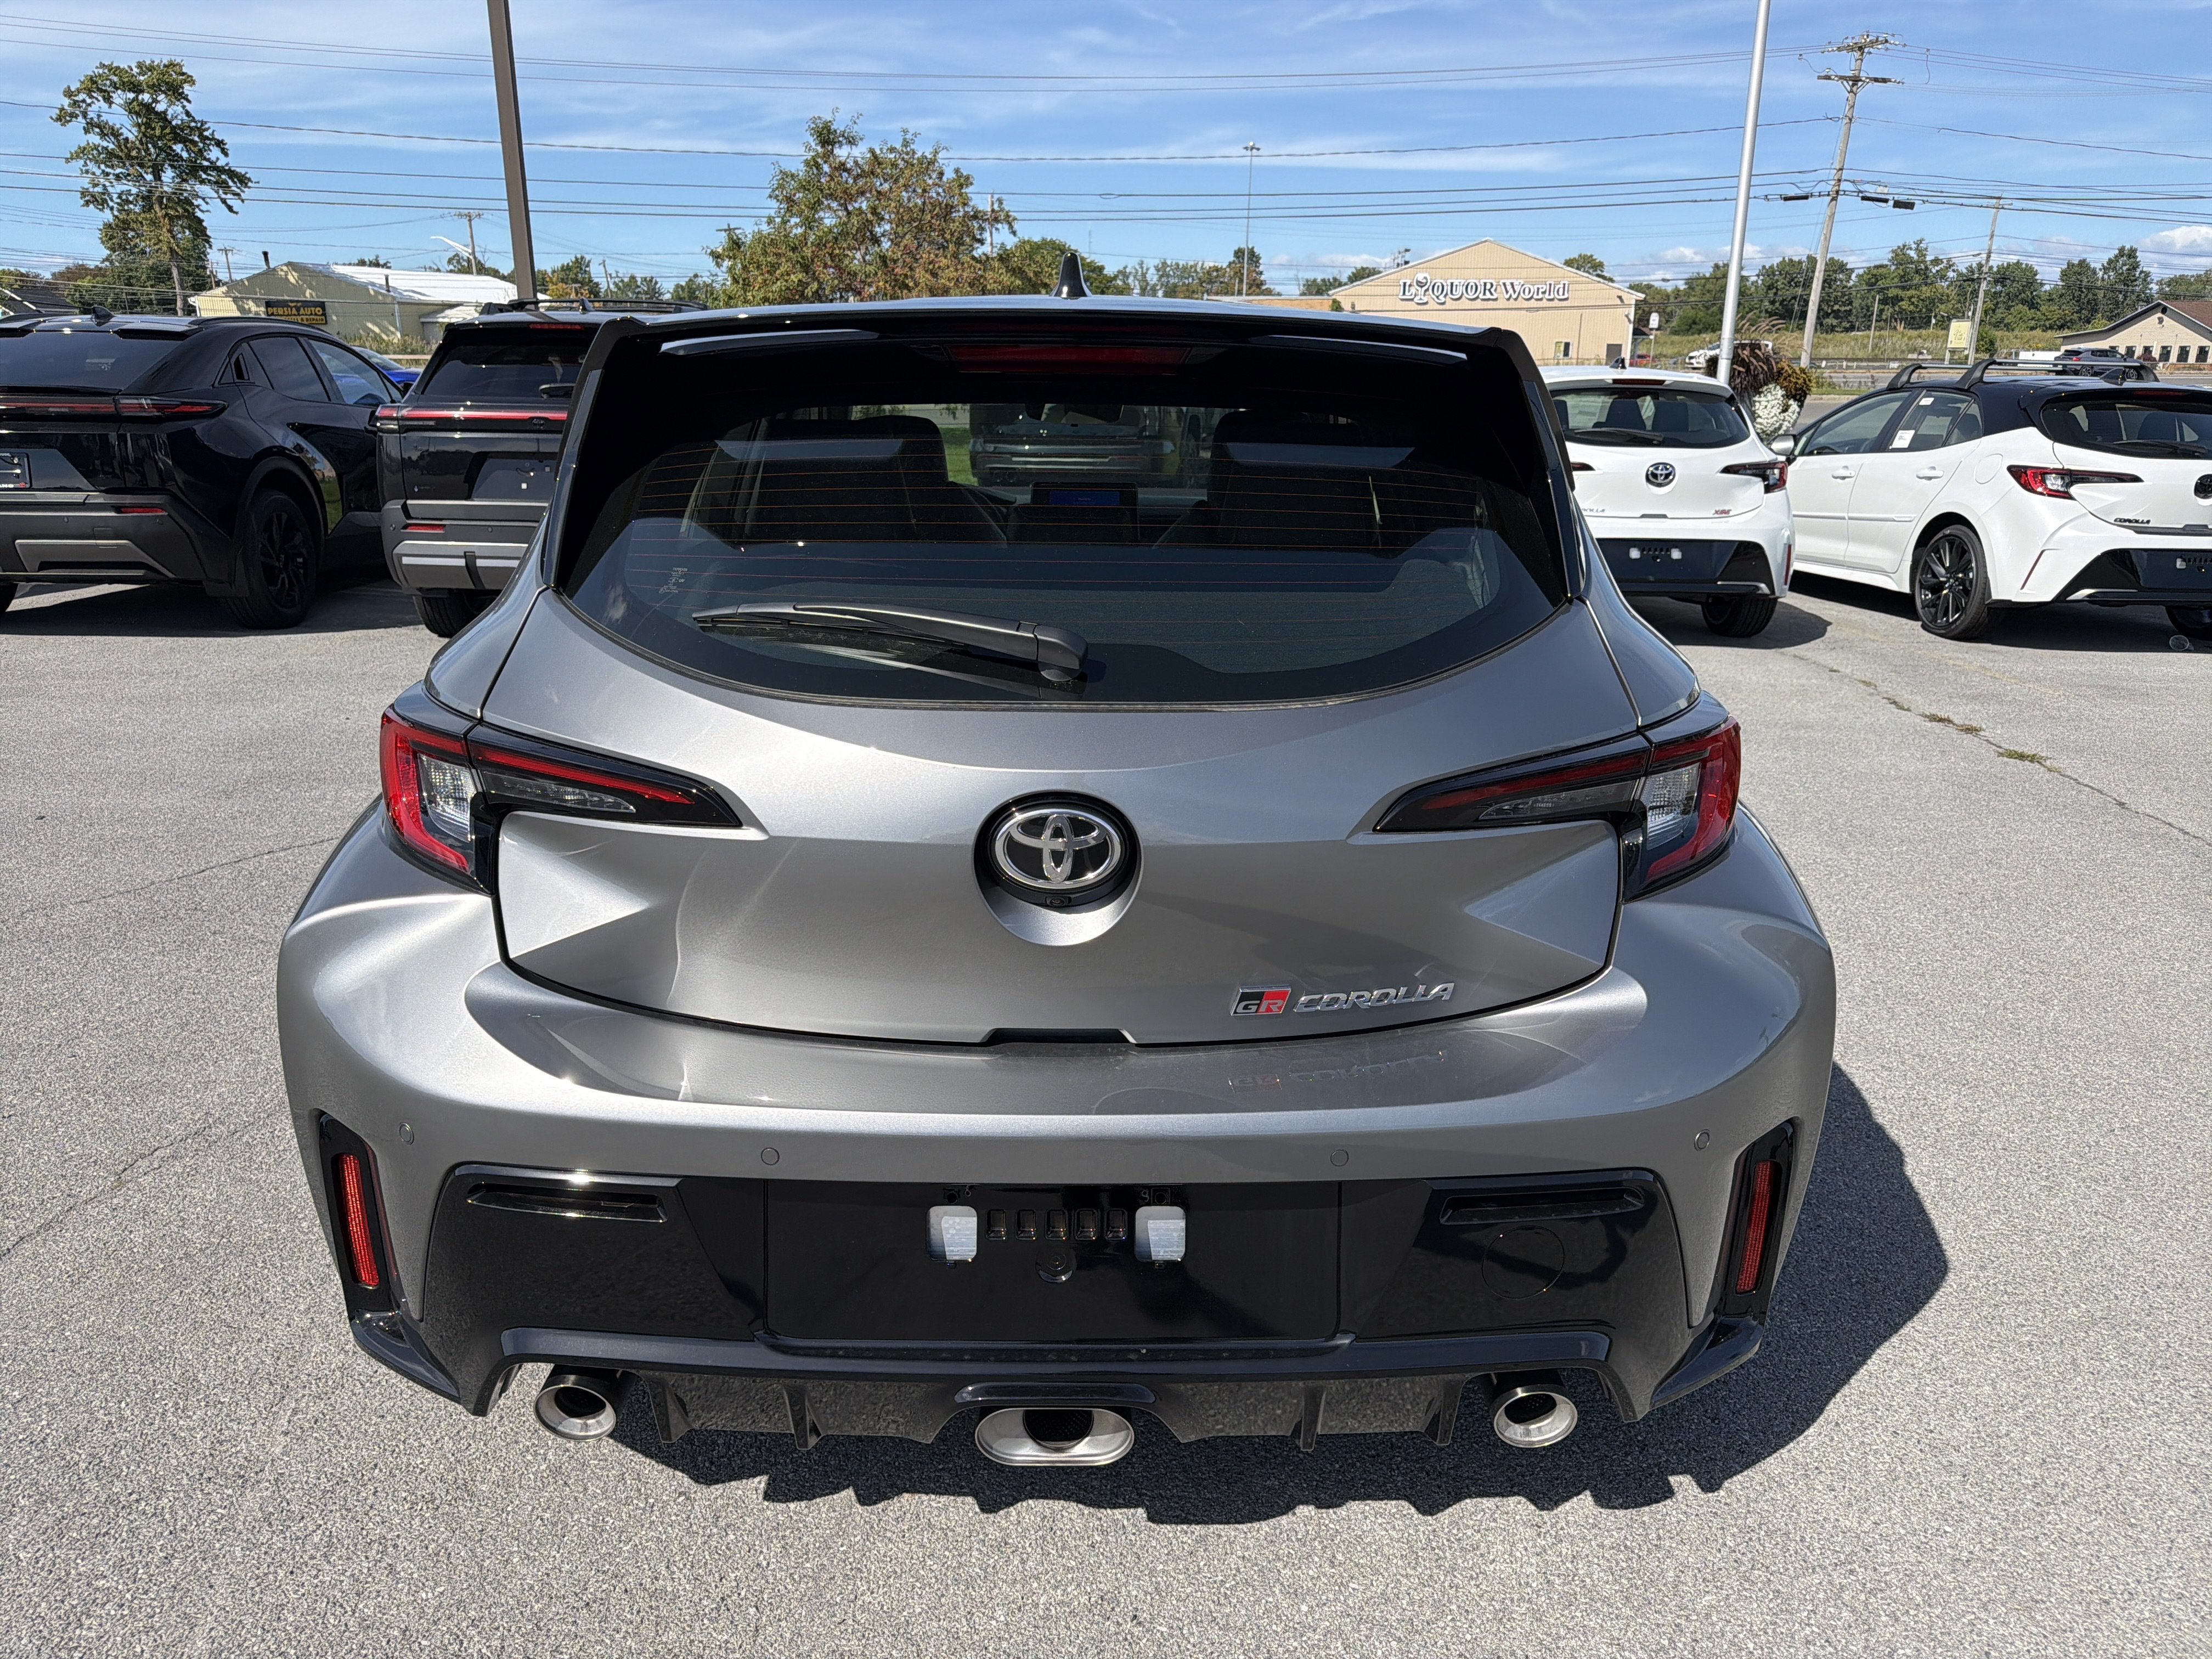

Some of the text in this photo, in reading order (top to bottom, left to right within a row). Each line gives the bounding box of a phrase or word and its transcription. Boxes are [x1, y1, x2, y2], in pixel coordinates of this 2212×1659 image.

[1499, 280, 1569, 300] World
[267, 307, 323, 315] PERSIA AUTO
[1293, 982, 1455, 1013] COROLLA
